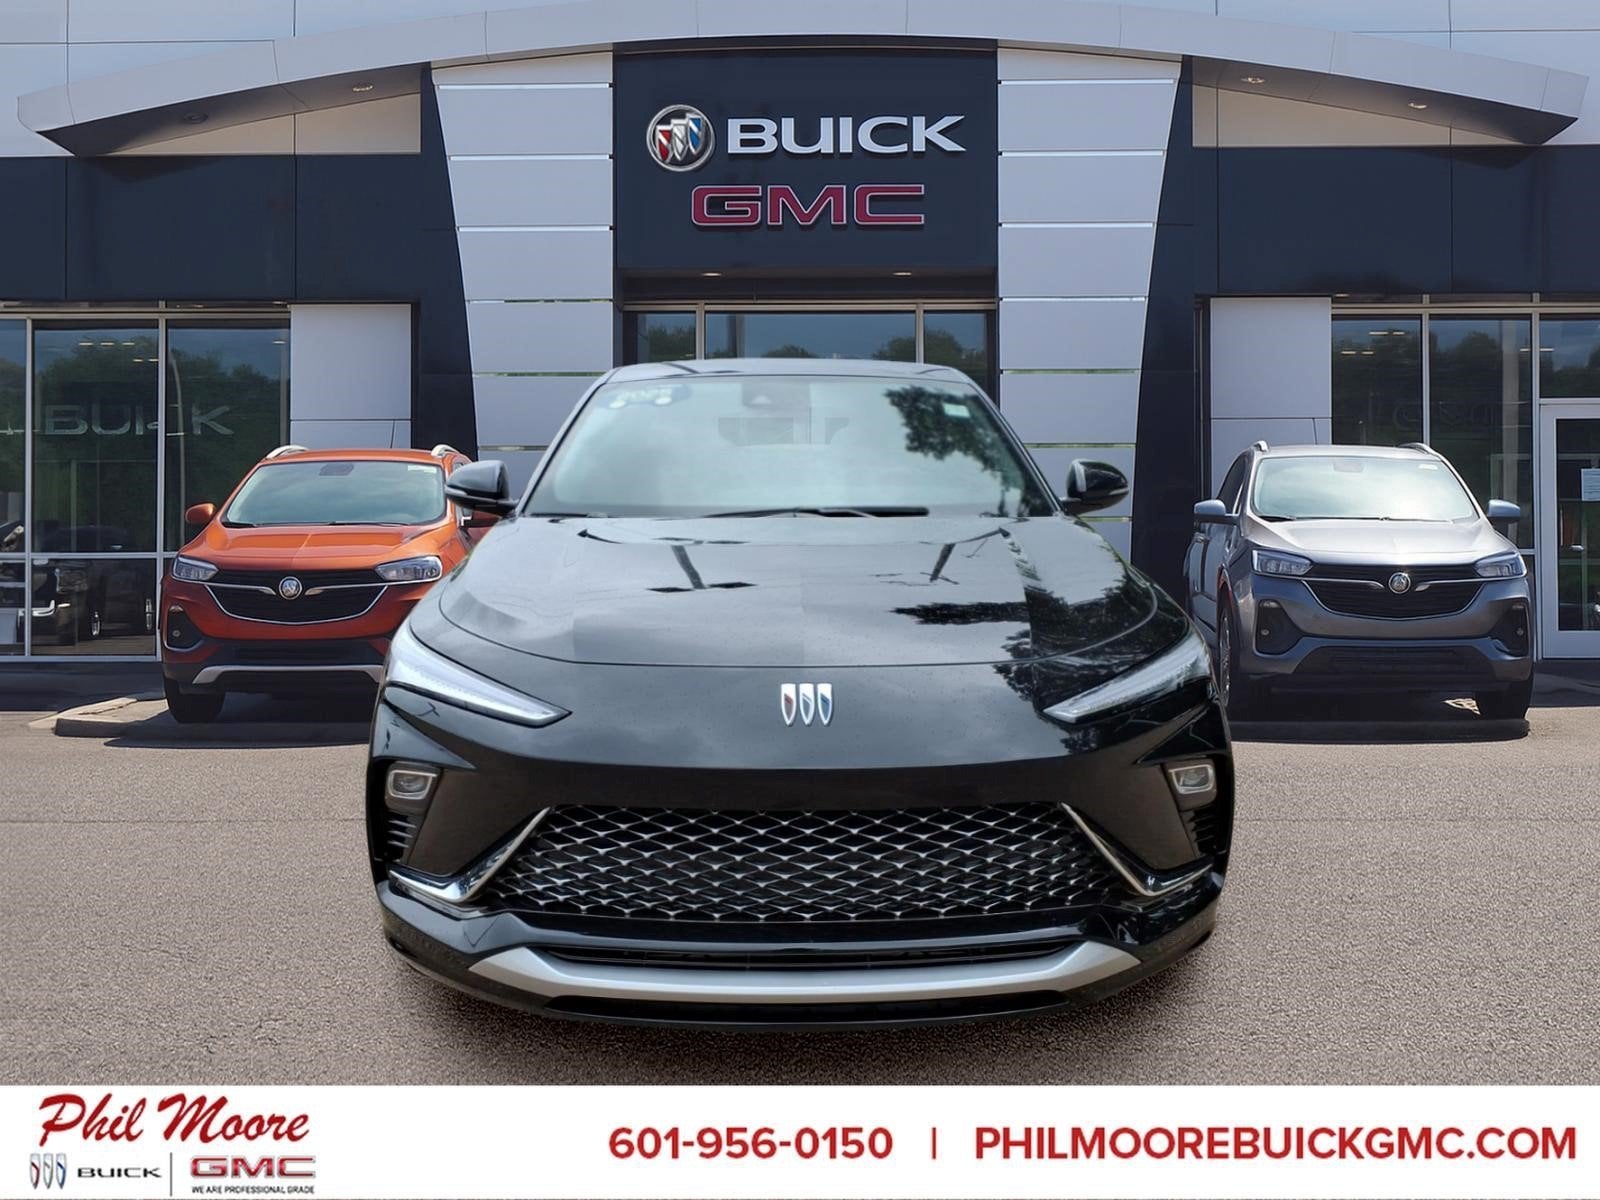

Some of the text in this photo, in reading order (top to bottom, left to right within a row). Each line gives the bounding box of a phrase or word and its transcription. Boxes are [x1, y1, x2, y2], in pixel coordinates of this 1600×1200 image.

[727, 115, 967, 154] BUICK
[691, 184, 925, 227] GMC
[44, 404, 234, 435] BUIK
